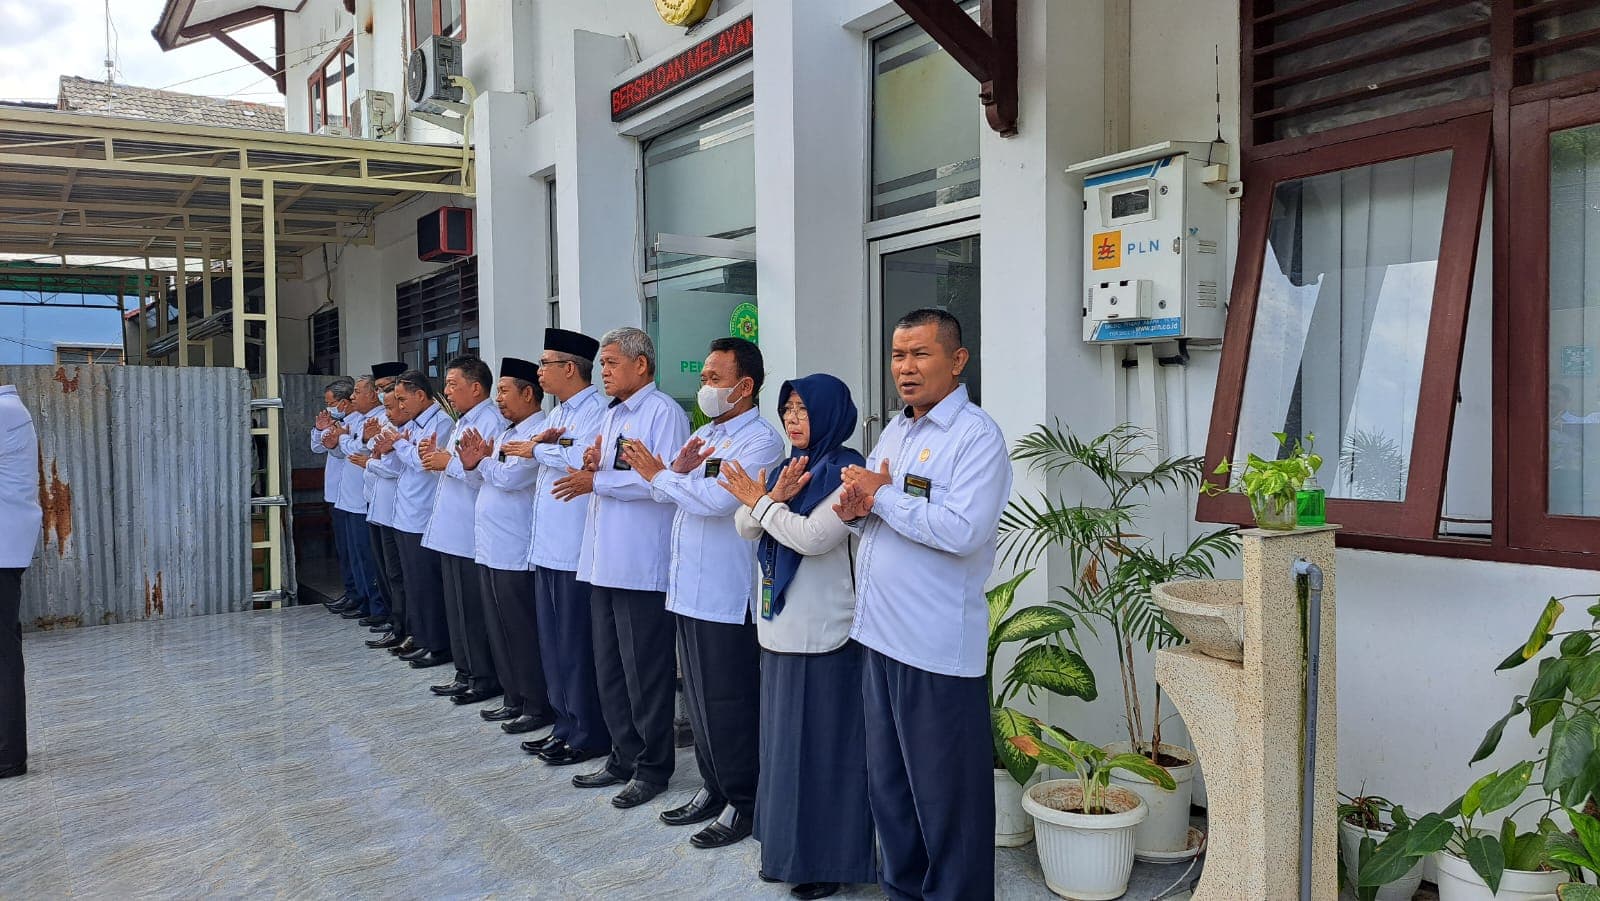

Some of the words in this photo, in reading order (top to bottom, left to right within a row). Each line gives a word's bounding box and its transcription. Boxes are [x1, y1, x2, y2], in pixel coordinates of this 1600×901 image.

[612, 72, 655, 113] BERSIH
[657, 55, 686, 91] DAN
[1127, 239, 1160, 255] PLN
